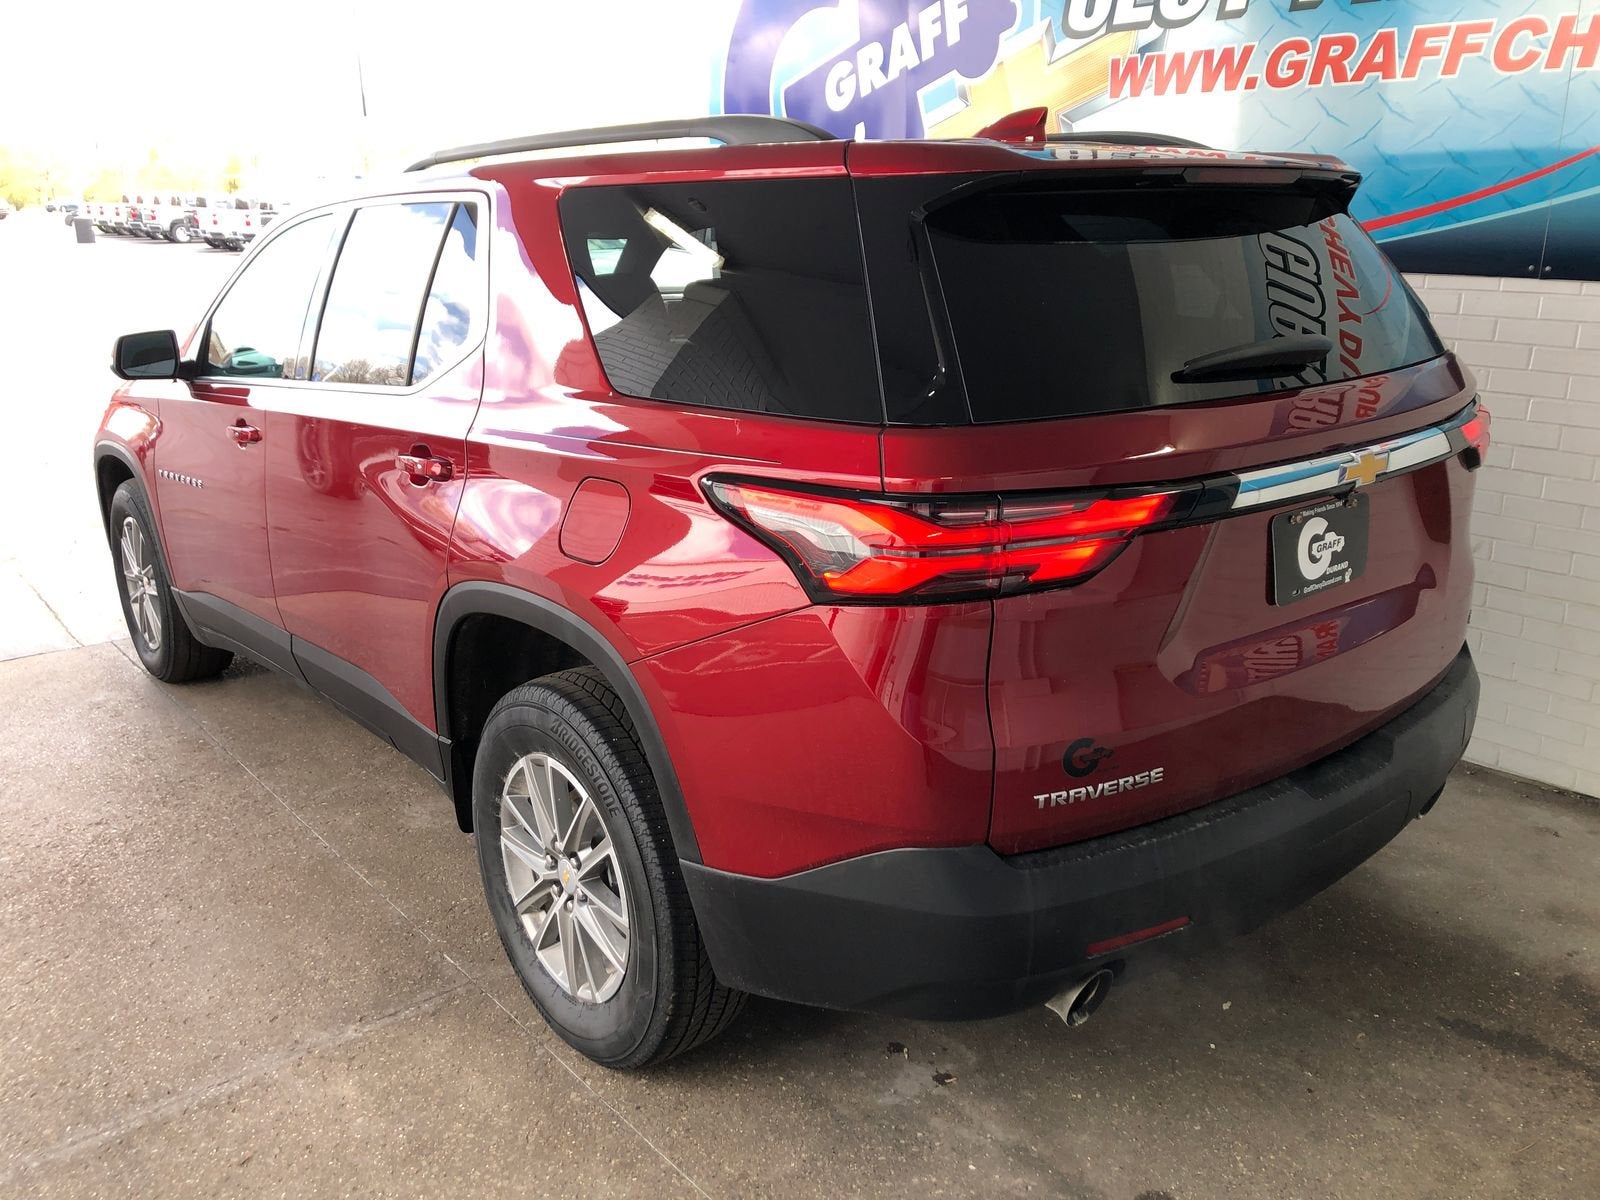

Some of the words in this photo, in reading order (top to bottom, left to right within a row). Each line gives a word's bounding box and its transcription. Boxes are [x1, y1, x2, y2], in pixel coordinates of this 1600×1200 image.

[824, 0, 969, 112] GRAFF
[1109, 13, 1600, 99] WWW.GRAFFCH
[158, 469, 204, 489] TRAVERSE
[1316, 538, 1342, 553] GRAFF
[1326, 561, 1349, 575] DURAND
[550, 719, 620, 818] BRIDGESTONE
[1033, 767, 1164, 809] TRAVERSE
